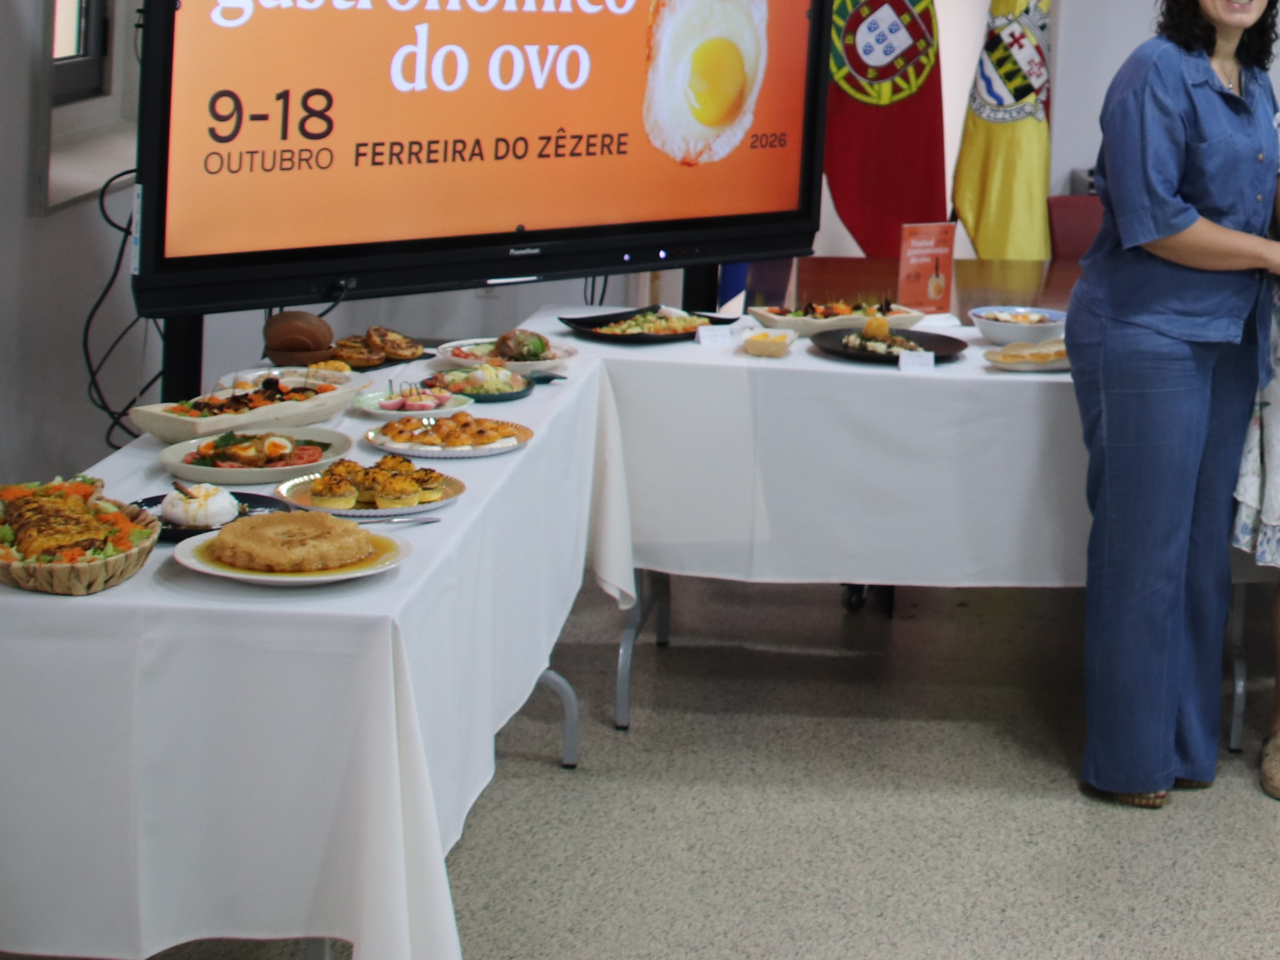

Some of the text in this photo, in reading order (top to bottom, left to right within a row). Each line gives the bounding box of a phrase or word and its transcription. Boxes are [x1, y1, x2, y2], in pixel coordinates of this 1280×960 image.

[390, 22, 592, 92] do ovo
[207, 88, 334, 143] 9-18
[354, 127, 629, 167] FERREIRA DO ZÊZERE
[750, 132, 787, 149] 2026
[203, 147, 334, 175] OUTUBRO
